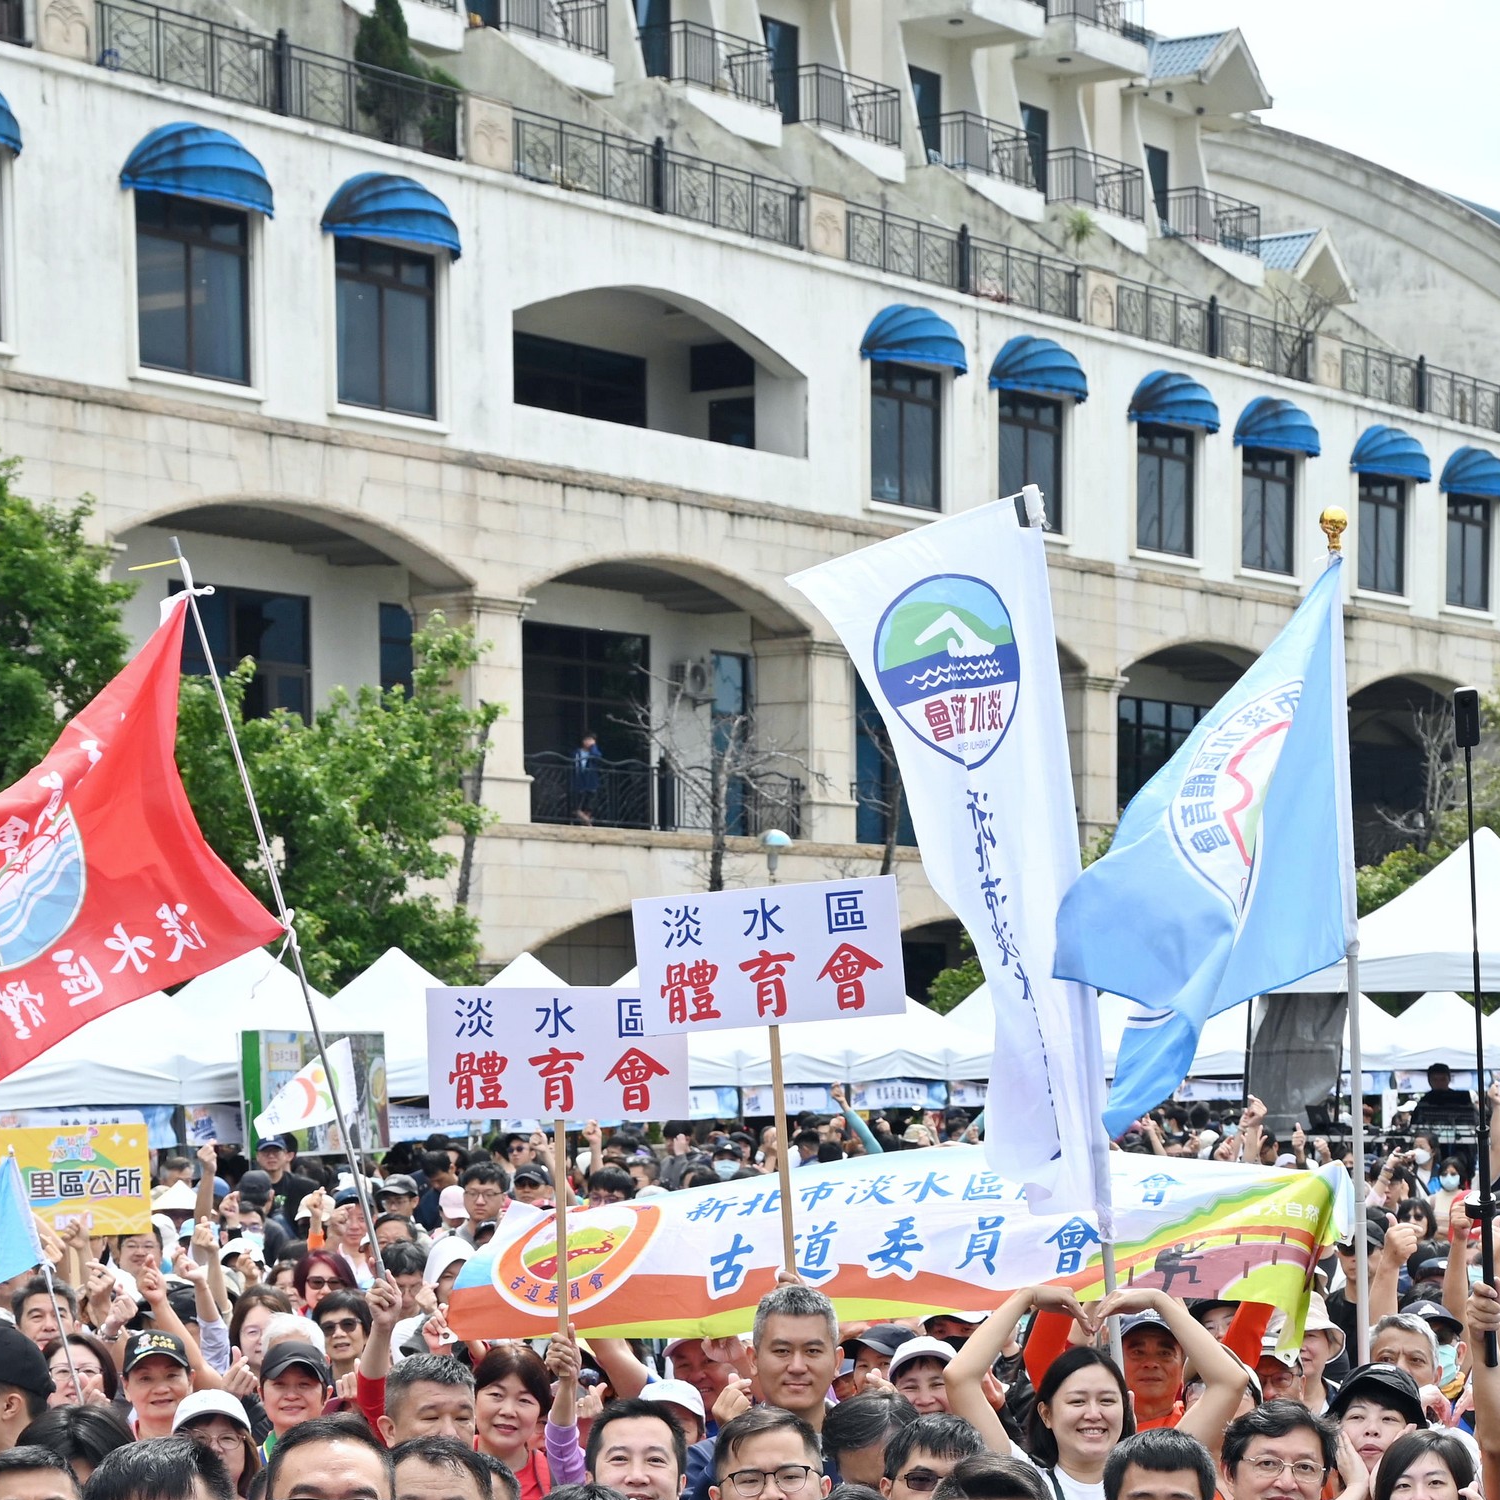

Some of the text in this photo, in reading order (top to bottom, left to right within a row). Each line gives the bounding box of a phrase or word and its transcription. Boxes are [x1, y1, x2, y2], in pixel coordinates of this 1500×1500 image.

[662, 889, 868, 949] 淡水區
[660, 942, 884, 1025] 體育會
[455, 997, 644, 1039] 淡水區
[449, 1046, 670, 1113] 體育會
[30, 1167, 142, 1200] 里區公所
[686, 1171, 1185, 1223] 新北市淡水區會
[710, 1215, 1101, 1292] 古道委員會
